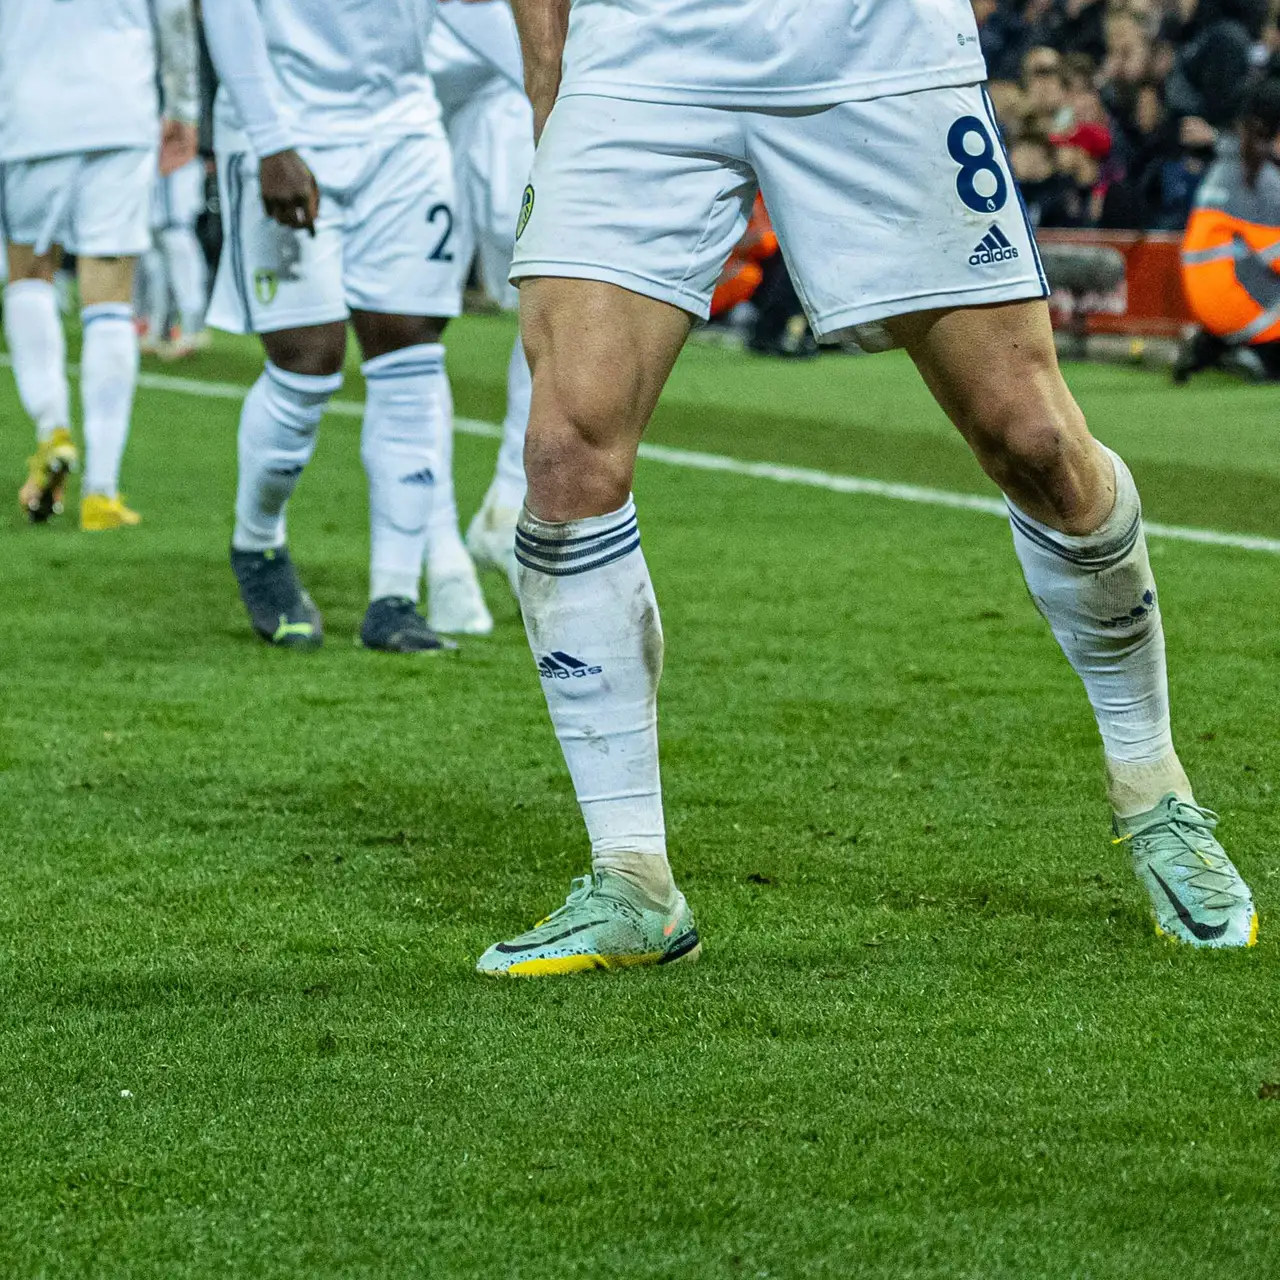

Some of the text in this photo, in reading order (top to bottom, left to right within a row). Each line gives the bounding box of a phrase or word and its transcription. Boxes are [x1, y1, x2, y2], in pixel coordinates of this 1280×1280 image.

[947, 115, 1008, 214] 8
[426, 203, 454, 261] 2
[969, 246, 1019, 266] adidas
